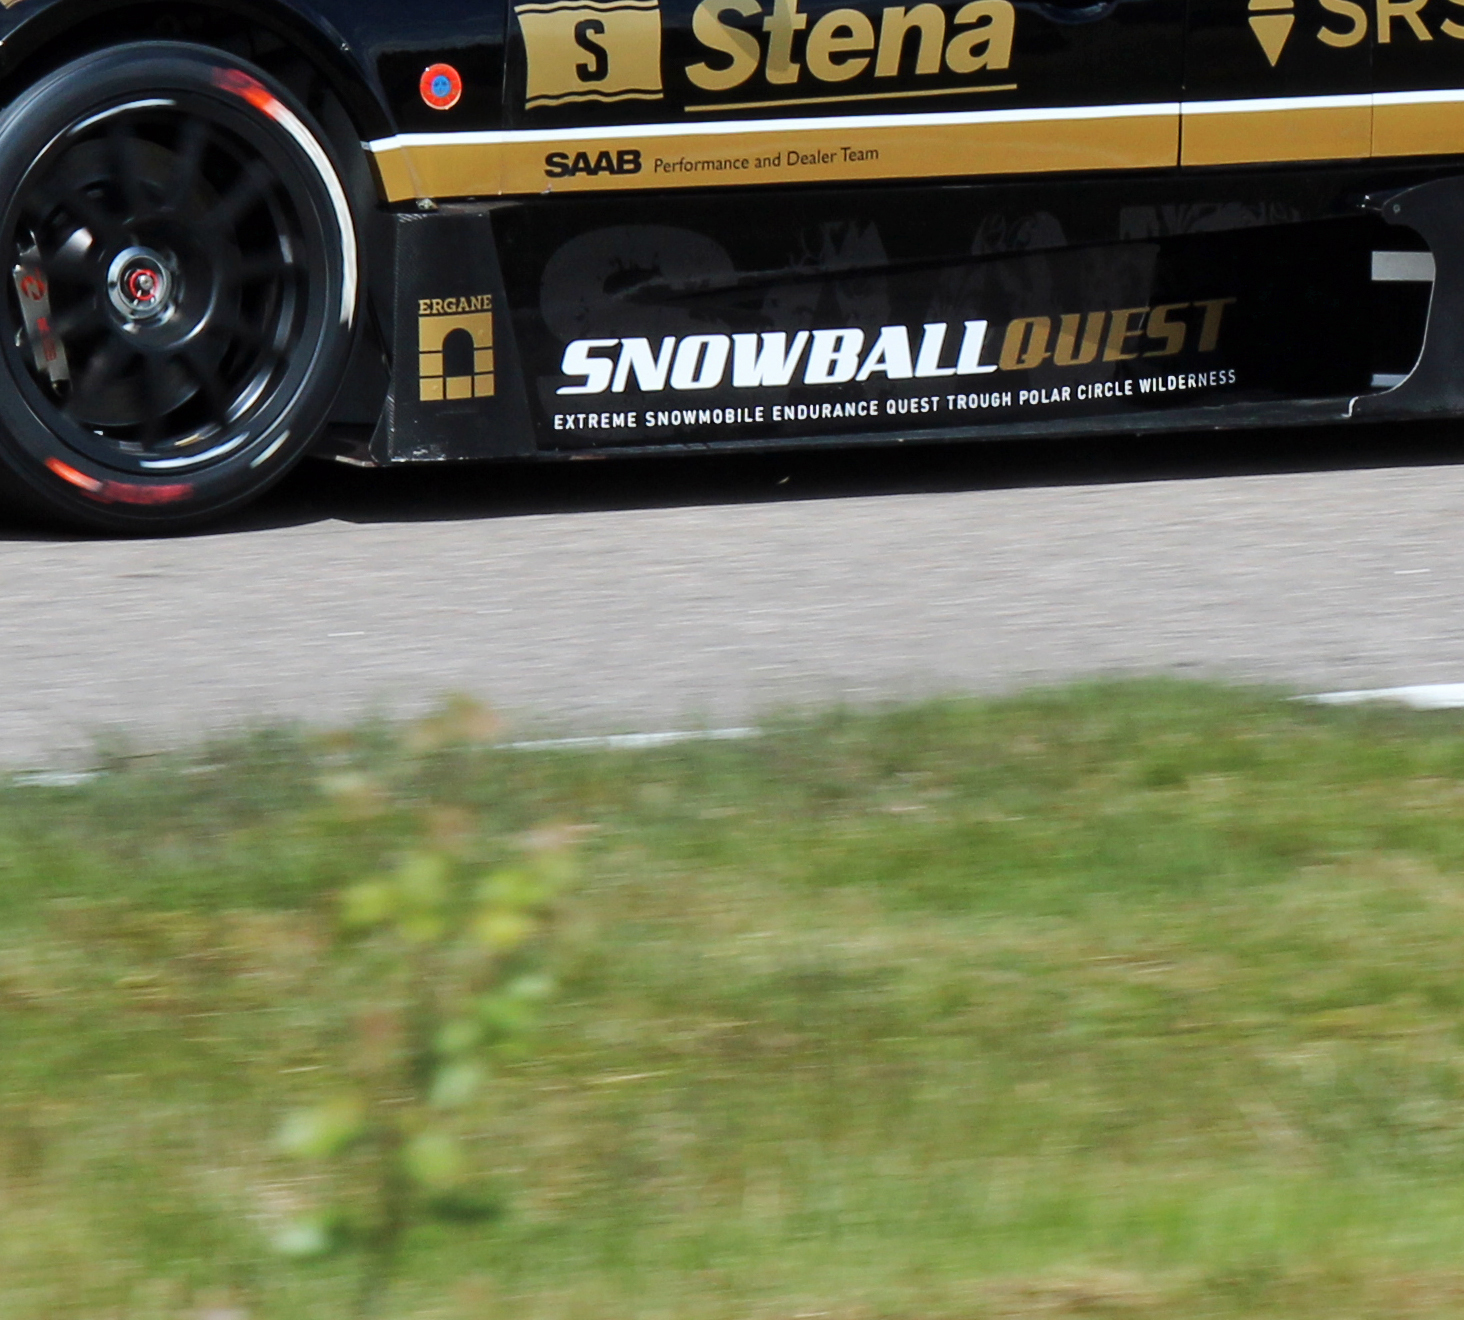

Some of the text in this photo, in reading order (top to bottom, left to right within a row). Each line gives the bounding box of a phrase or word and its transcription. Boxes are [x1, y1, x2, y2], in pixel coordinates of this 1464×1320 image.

[575, 19, 609, 82] S
[544, 146, 880, 178] SAAB Performance and Dealer Team
[418, 294, 492, 315] ERGANE
[554, 369, 1237, 430] EXTREME SNOWMOBILE ENDURANCE QUEST TROUGH POLAR CIRCLE WILDERNESS
